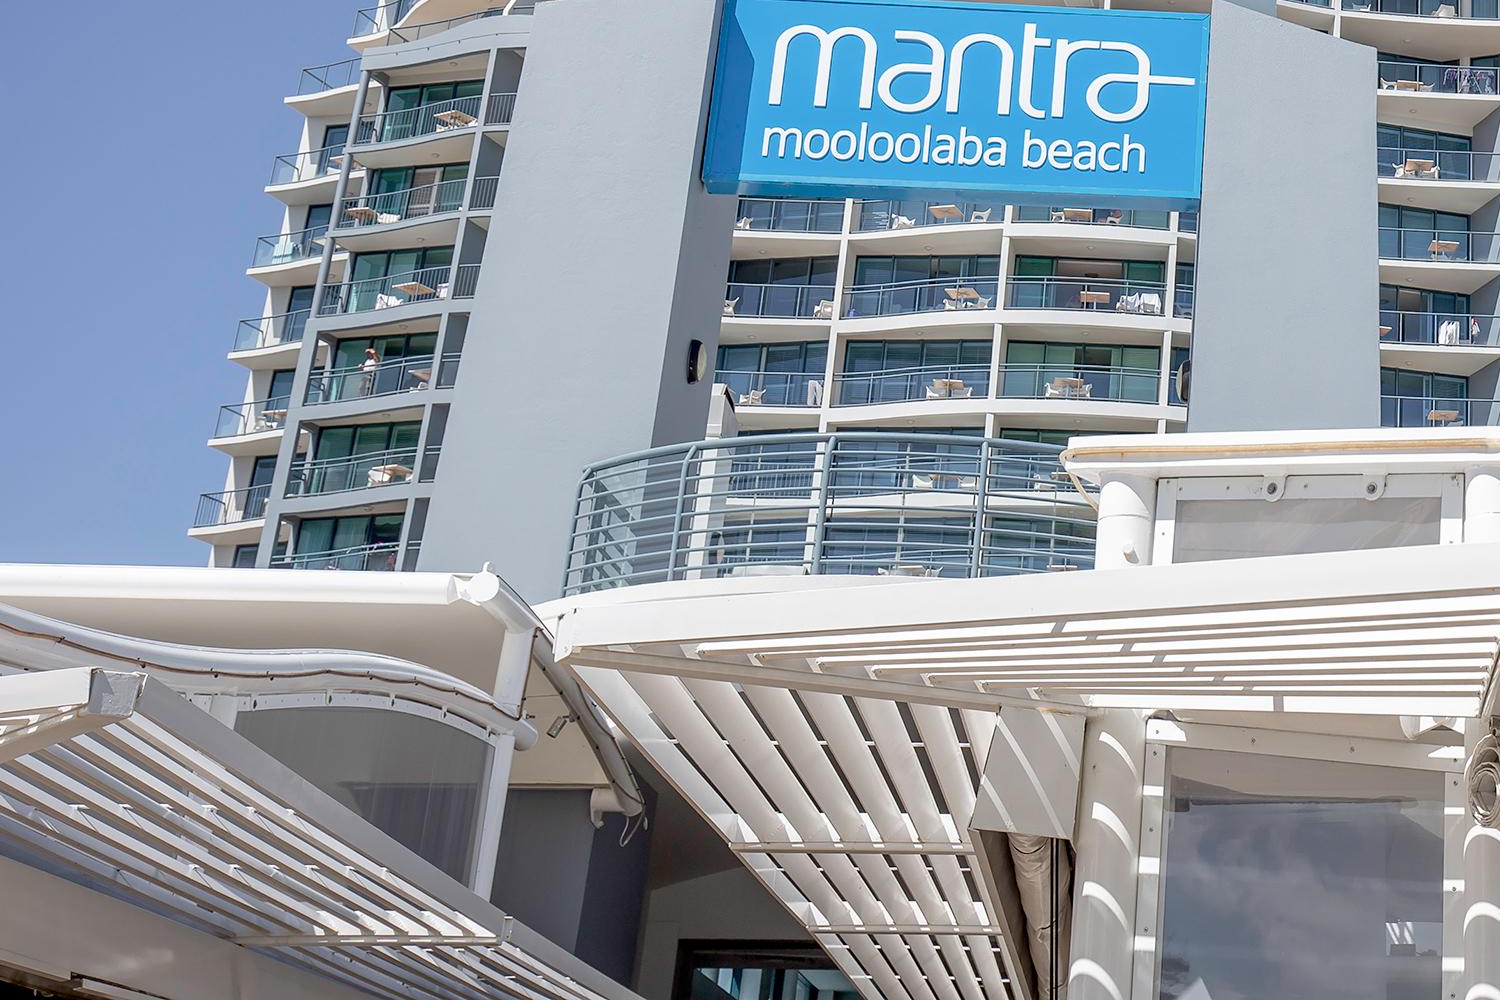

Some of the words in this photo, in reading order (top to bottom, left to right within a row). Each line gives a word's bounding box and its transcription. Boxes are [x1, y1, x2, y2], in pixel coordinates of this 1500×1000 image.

[768, 23, 1195, 122] mantra
[761, 122, 1007, 167] mooloolaba
[1021, 130, 1146, 173] beach
